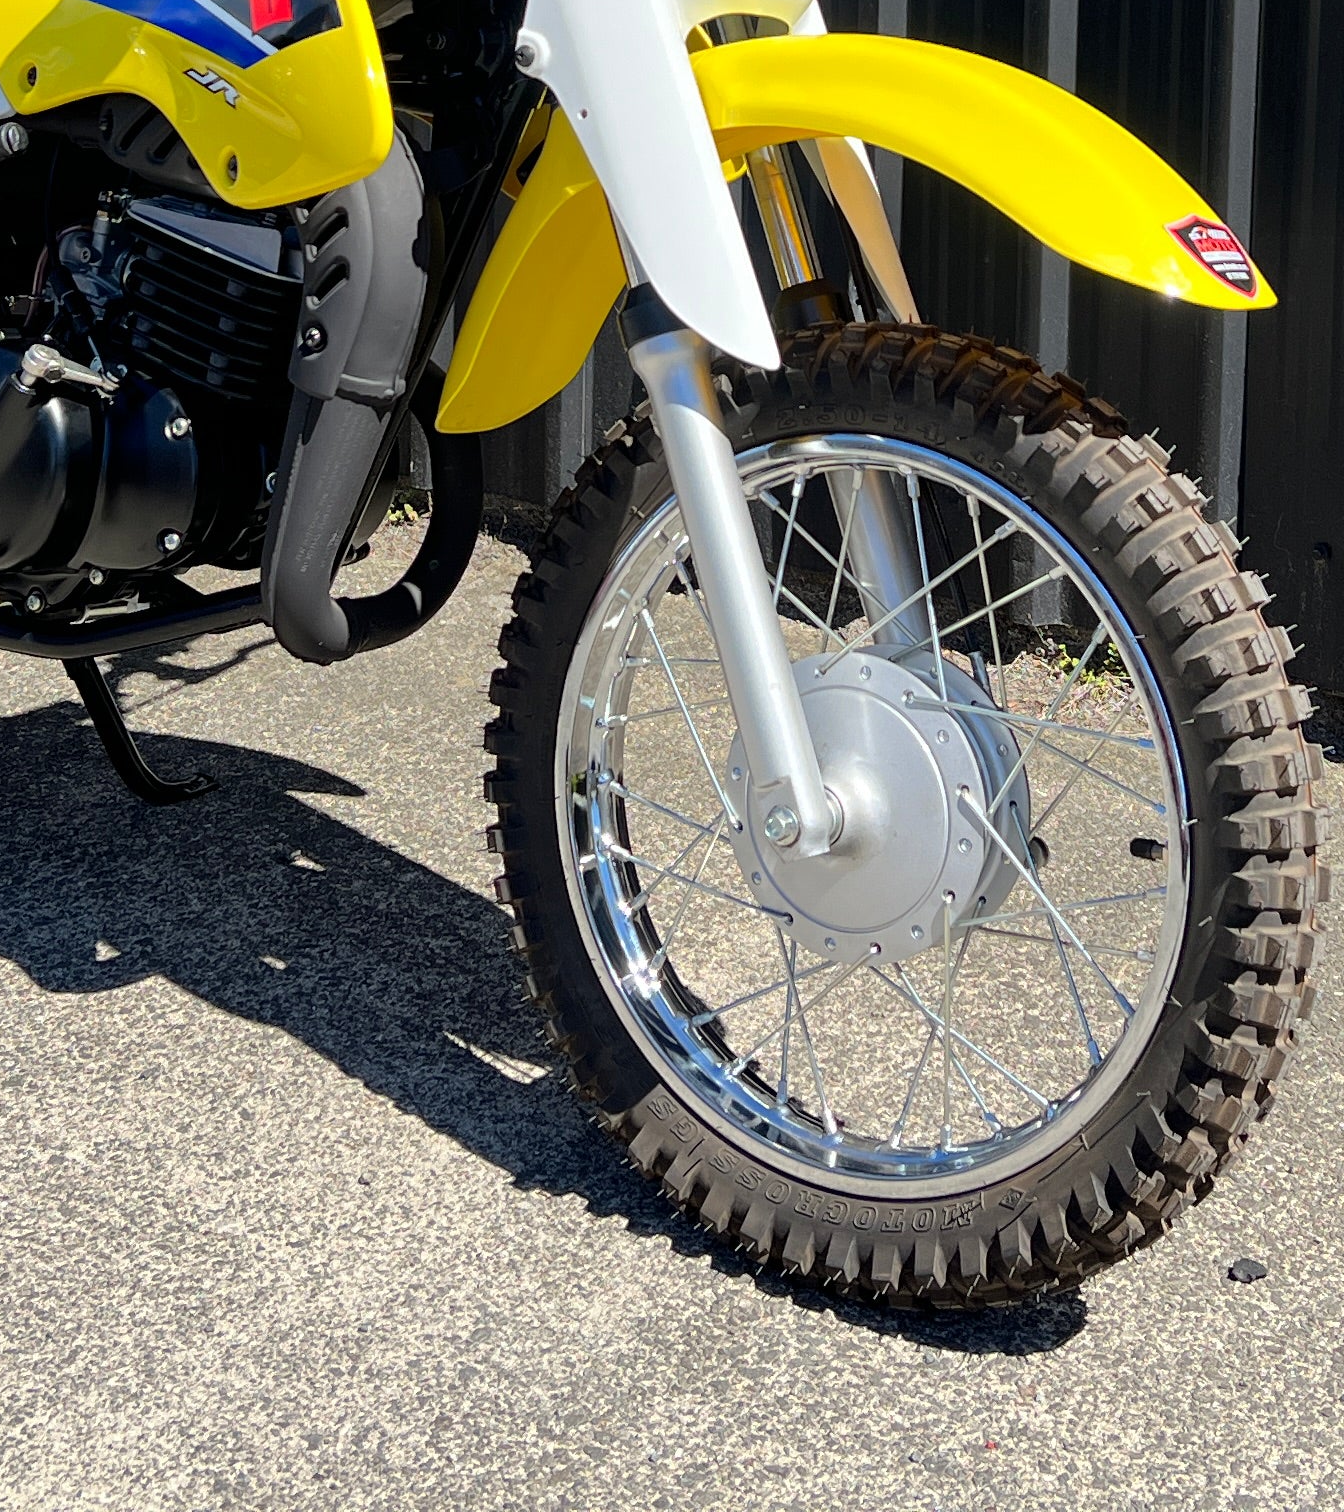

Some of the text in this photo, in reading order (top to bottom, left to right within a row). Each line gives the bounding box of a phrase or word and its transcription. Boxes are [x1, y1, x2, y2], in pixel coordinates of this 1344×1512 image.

[184, 67, 241, 109] JR
[1193, 238, 1239, 252] MOTO
[708, 1144, 977, 1235] MOTOCROSS
